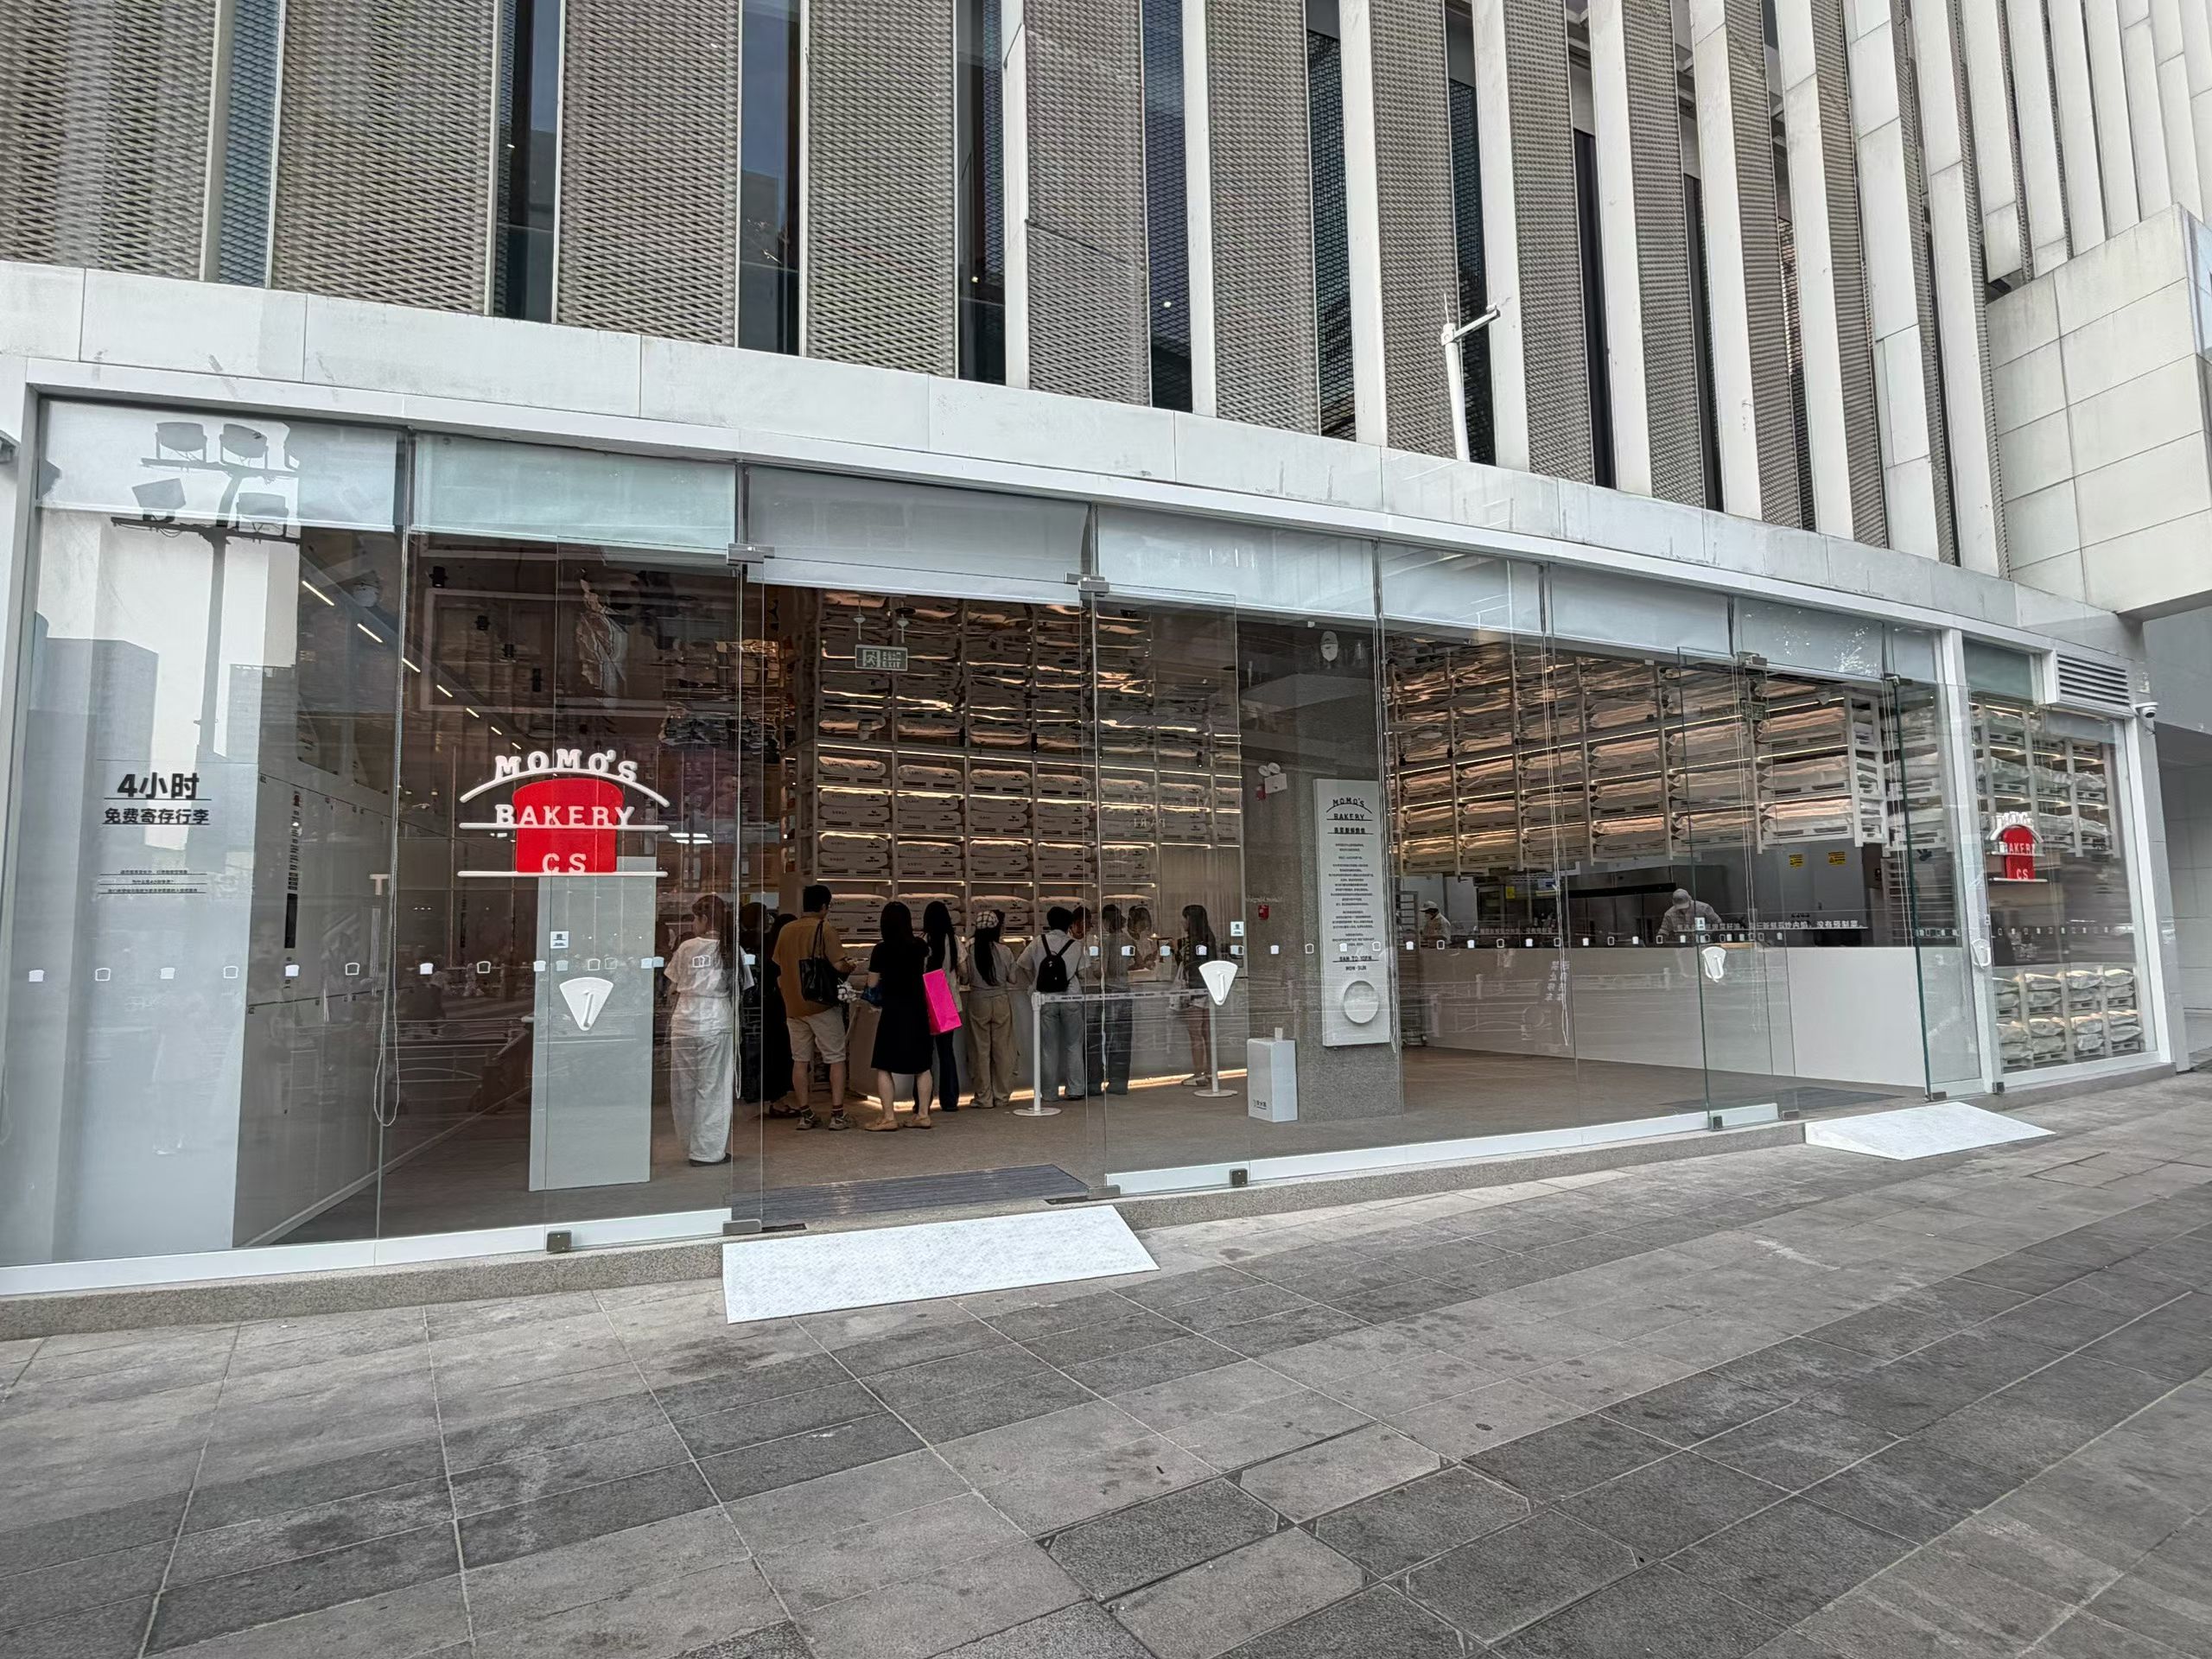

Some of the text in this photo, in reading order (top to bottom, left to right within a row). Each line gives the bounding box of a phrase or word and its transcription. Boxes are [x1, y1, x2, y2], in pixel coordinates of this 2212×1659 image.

[495, 749, 638, 782] MOMO'S
[117, 772, 200, 799] 4小时
[1332, 797, 1364, 807] MOMO'S
[104, 808, 209, 823] 免费寄存行李
[495, 804, 635, 826] BAKERY
[542, 853, 587, 873] CS
[2016, 868, 2029, 880] CS
